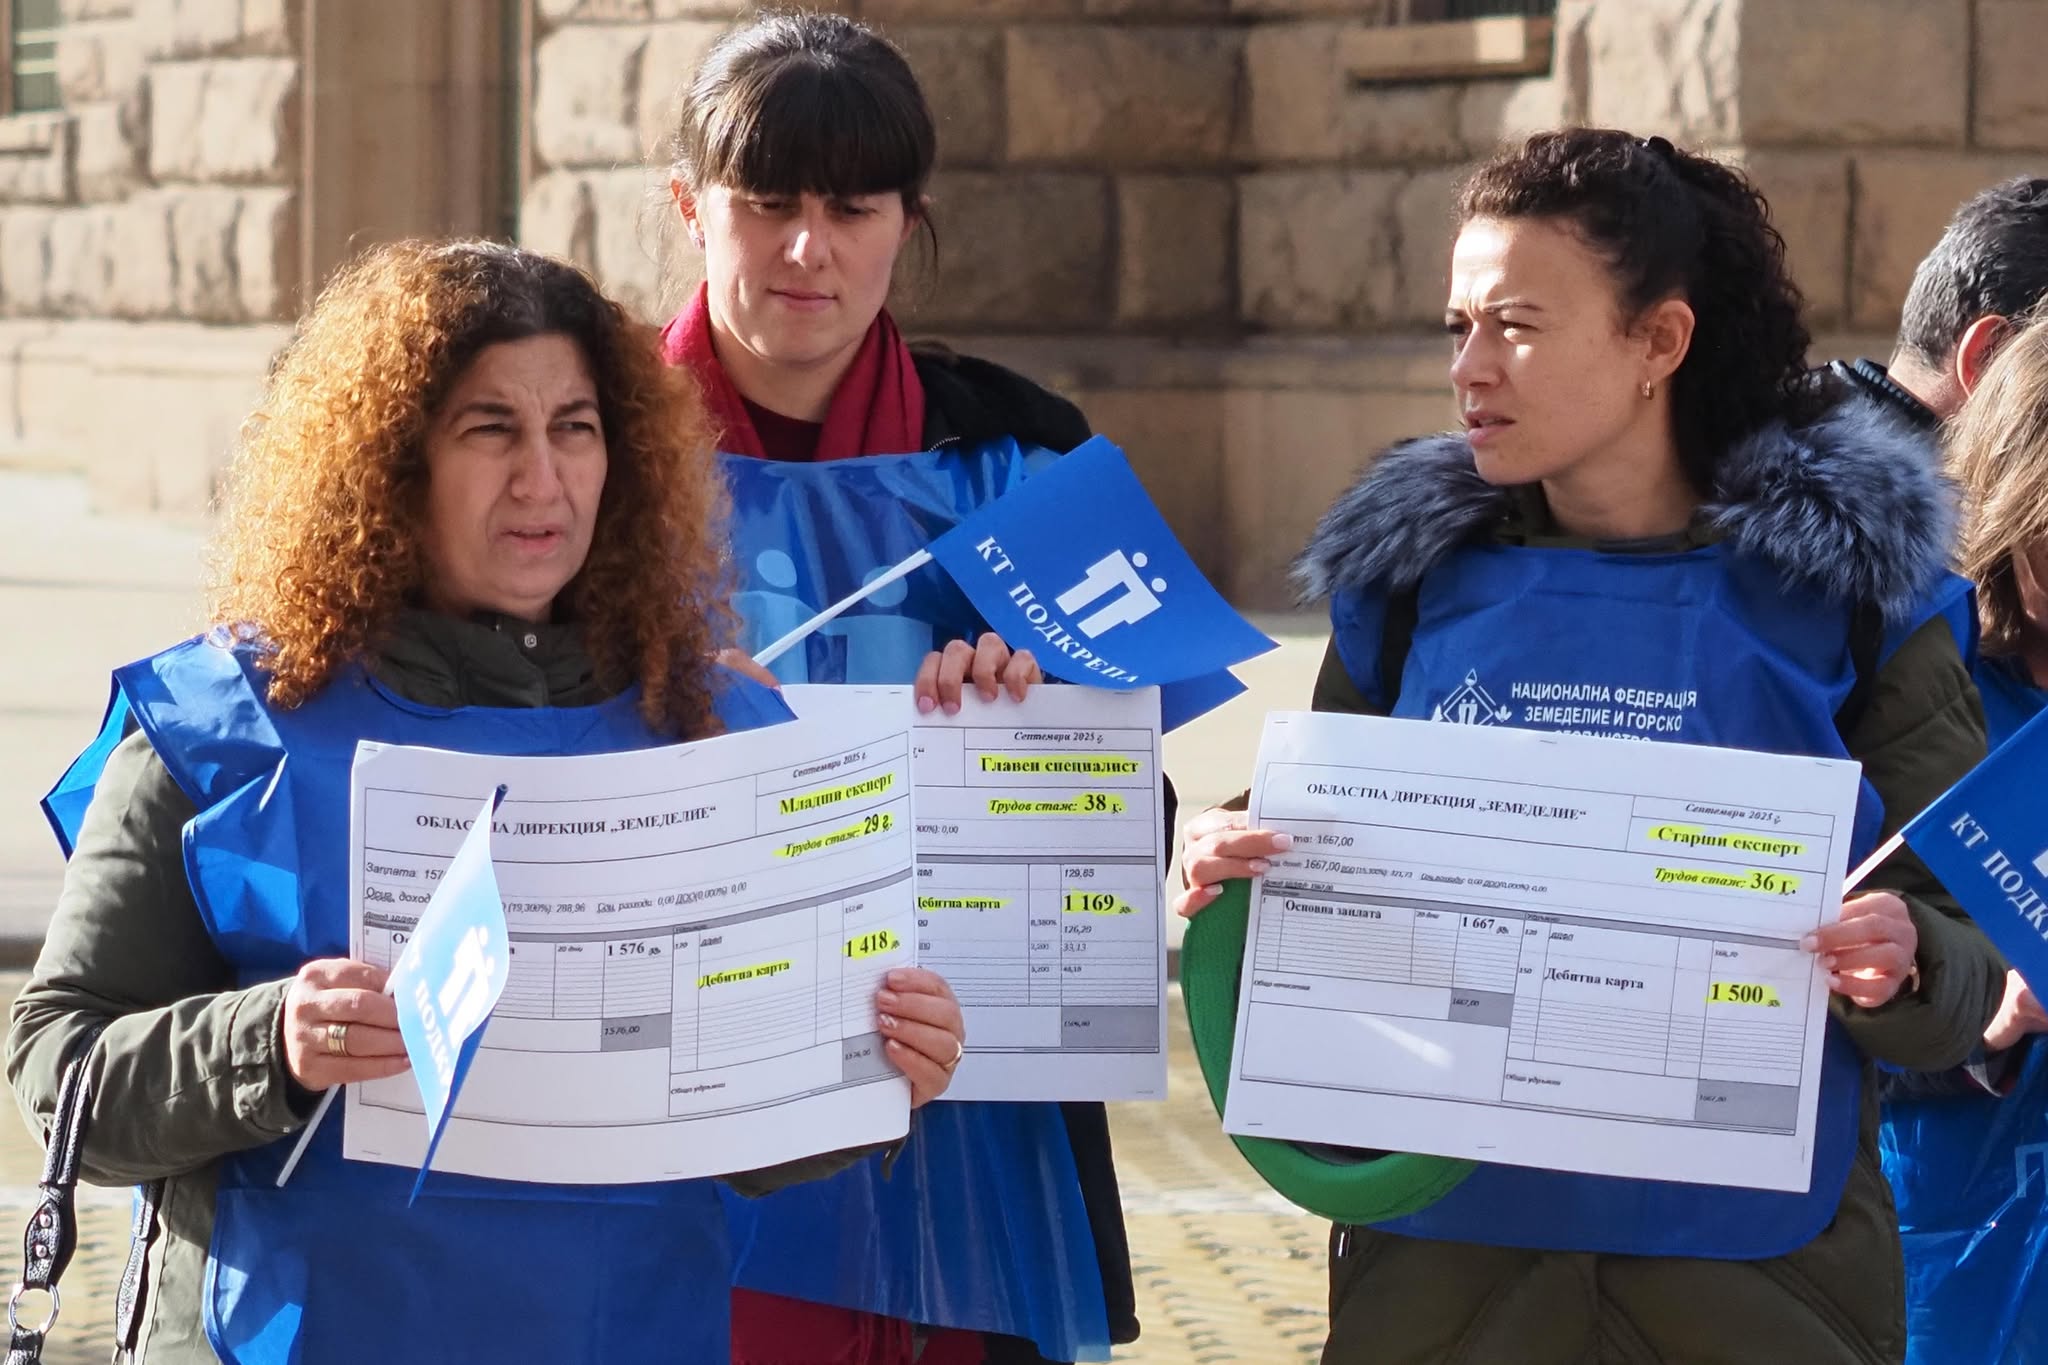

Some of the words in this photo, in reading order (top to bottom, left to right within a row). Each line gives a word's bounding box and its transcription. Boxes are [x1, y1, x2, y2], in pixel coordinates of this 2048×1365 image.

[975, 536, 1015, 576] КТ
[1008, 581, 1139, 683] ПОДКРЕПА
[1511, 682, 1610, 703] НАЦИОНАЛНА
[1524, 705, 1610, 726] ЗЕМЕДЕЛИЕ
[1613, 710, 1624, 725] И
[1626, 712, 1683, 732] ГОРСКО
[1014, 731, 1071, 742] Септември
[1073, 731, 1095, 742] 2025
[793, 759, 842, 779] Септември
[981, 756, 1040, 773] Главен
[1045, 761, 1139, 775] специалист
[779, 790, 842, 816] Младши
[845, 772, 894, 799] експерт
[990, 799, 1032, 813] Трудов
[1035, 802, 1078, 812] стаж:
[1084, 794, 1107, 812] 38
[1306, 783, 1389, 801] ОБЛАСТНА
[1391, 789, 1475, 810] ДИРЕКЦИЯ
[1478, 799, 1588, 821] „ЗЕМЕДЕЛИЕ“
[416, 814, 509, 835] ОБЛАСА
[513, 820, 606, 837] ДИРЕКЦИЯ
[610, 806, 717, 834] „ЗЕМЕДЕЛИЕ“
[1685, 802, 1746, 820] Септември
[1748, 810, 1773, 822] 2025
[785, 838, 822, 858] Трудов
[824, 829, 861, 848] стаж:
[863, 814, 880, 836] 29
[1950, 812, 1989, 848] КТ
[1317, 835, 1354, 847] 1667,00
[1657, 826, 1728, 849] Старши
[1733, 838, 1802, 857] експерт
[1656, 867, 1698, 884] Трудов
[1700, 874, 1747, 889] стаж:
[1750, 872, 1775, 892] 36
[917, 896, 963, 910] ебитна
[966, 899, 1000, 912] карта
[1064, 894, 1073, 911] 1
[1082, 894, 1115, 912] 169
[1285, 899, 1335, 915] Основна
[1335, 906, 1382, 919] заплата
[1462, 916, 1468, 927] 1
[1472, 916, 1496, 930] 667
[607, 945, 614, 957] 1
[620, 942, 645, 955] 576
[845, 940, 852, 958] 1
[859, 930, 888, 954] 418
[699, 967, 753, 990] Дебитна
[756, 960, 790, 978] карта
[1543, 967, 1602, 985] Дебитна
[1605, 976, 1644, 990] карта
[1711, 983, 1720, 1001] 1
[1728, 984, 1764, 1004] 500
